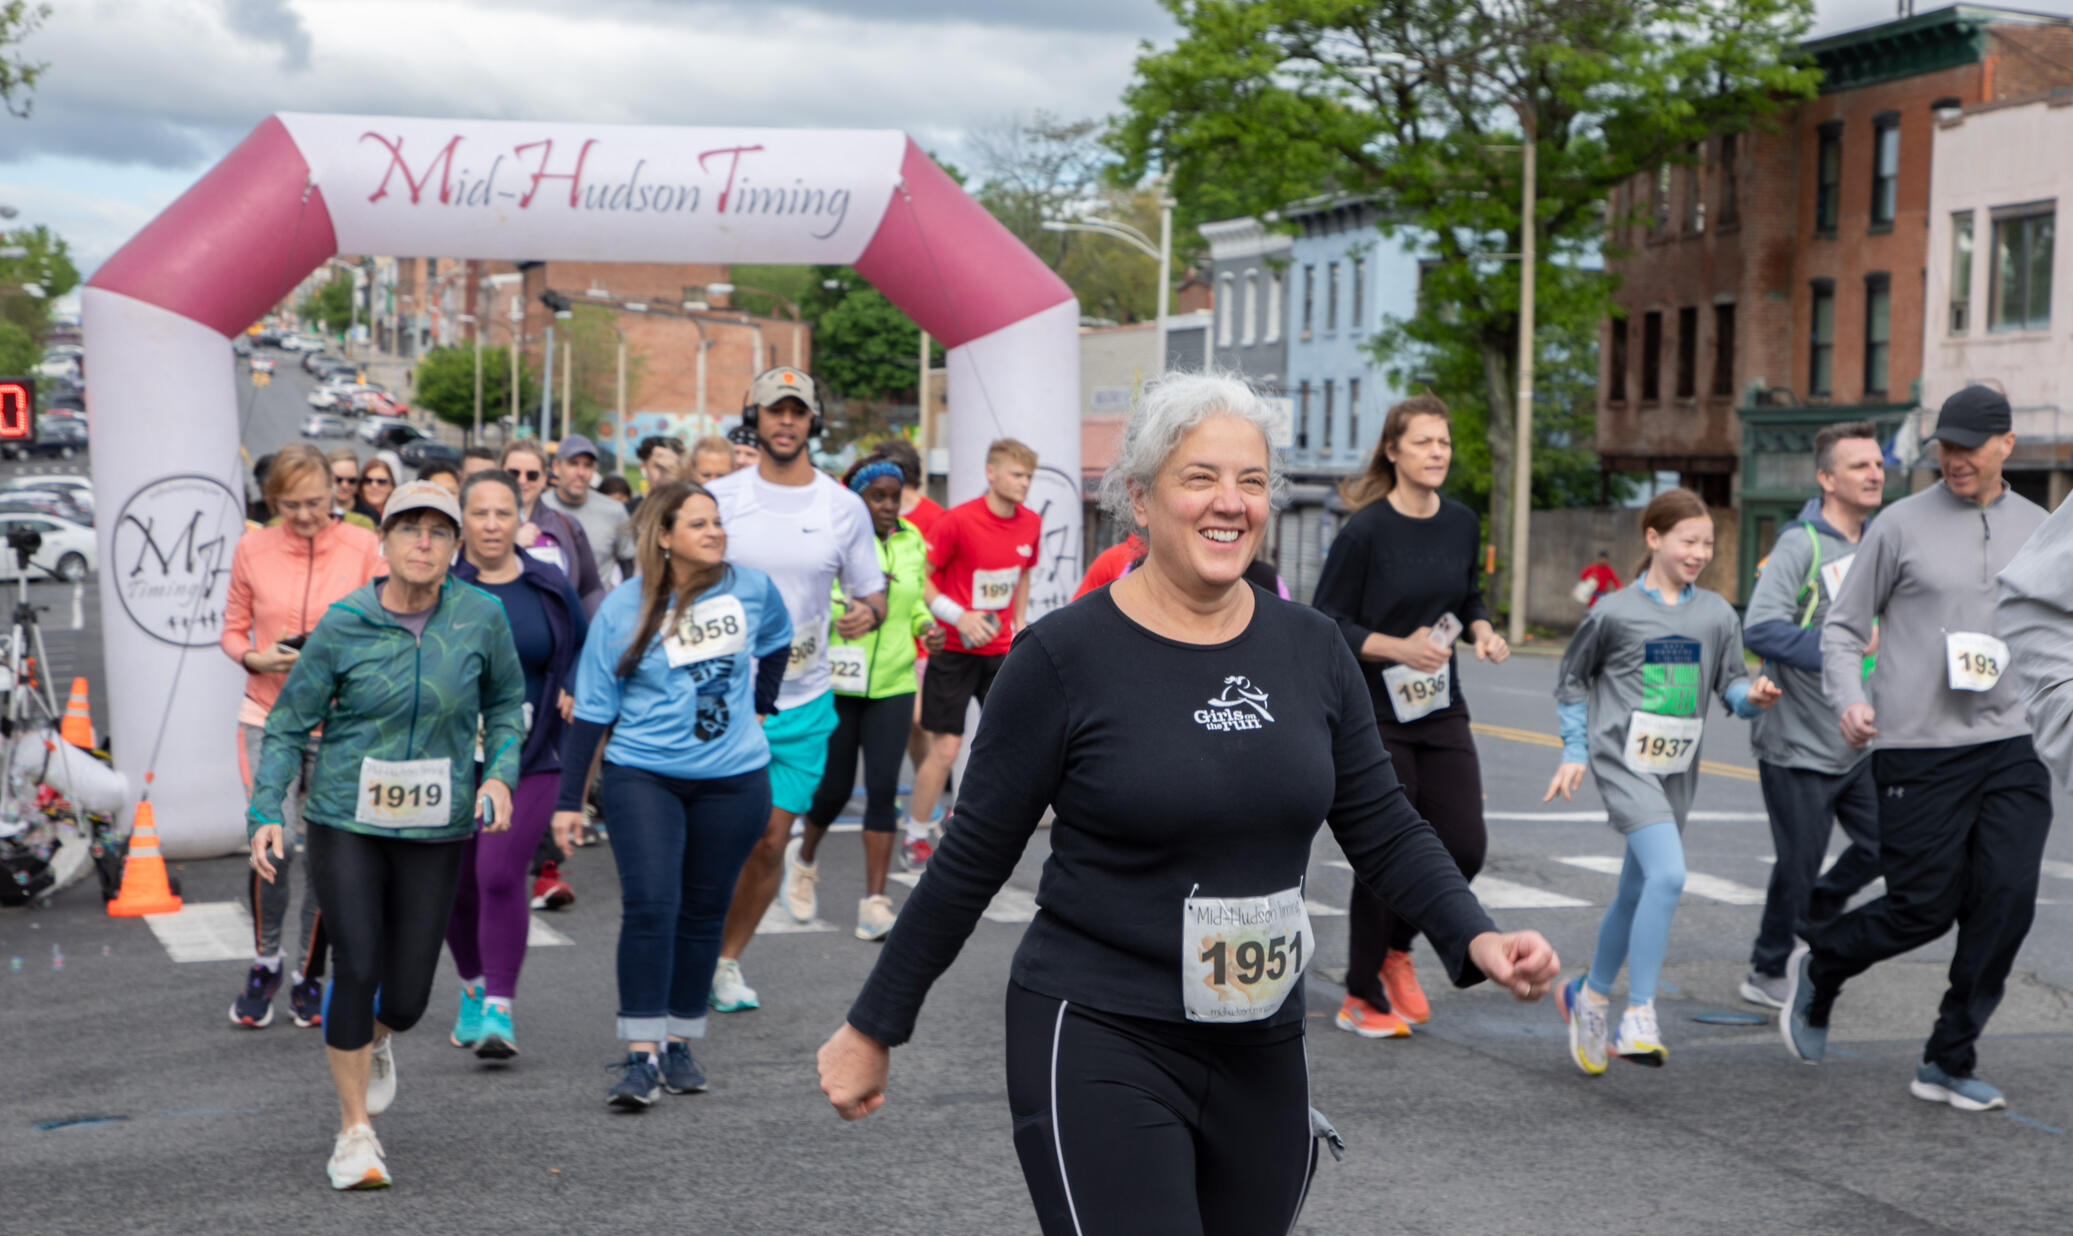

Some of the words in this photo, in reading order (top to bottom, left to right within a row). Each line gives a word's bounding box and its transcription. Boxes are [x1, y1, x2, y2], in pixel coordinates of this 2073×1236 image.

[358, 131, 701, 214] Mid-Hudson
[697, 144, 851, 240] Timing
[1193, 708, 1244, 724] Girls
[1244, 713, 1257, 721] on
[1206, 723, 1223, 731] the
[1636, 734, 1694, 759] 1937
[367, 783, 443, 808] 1919
[1201, 930, 1303, 986] 1951
